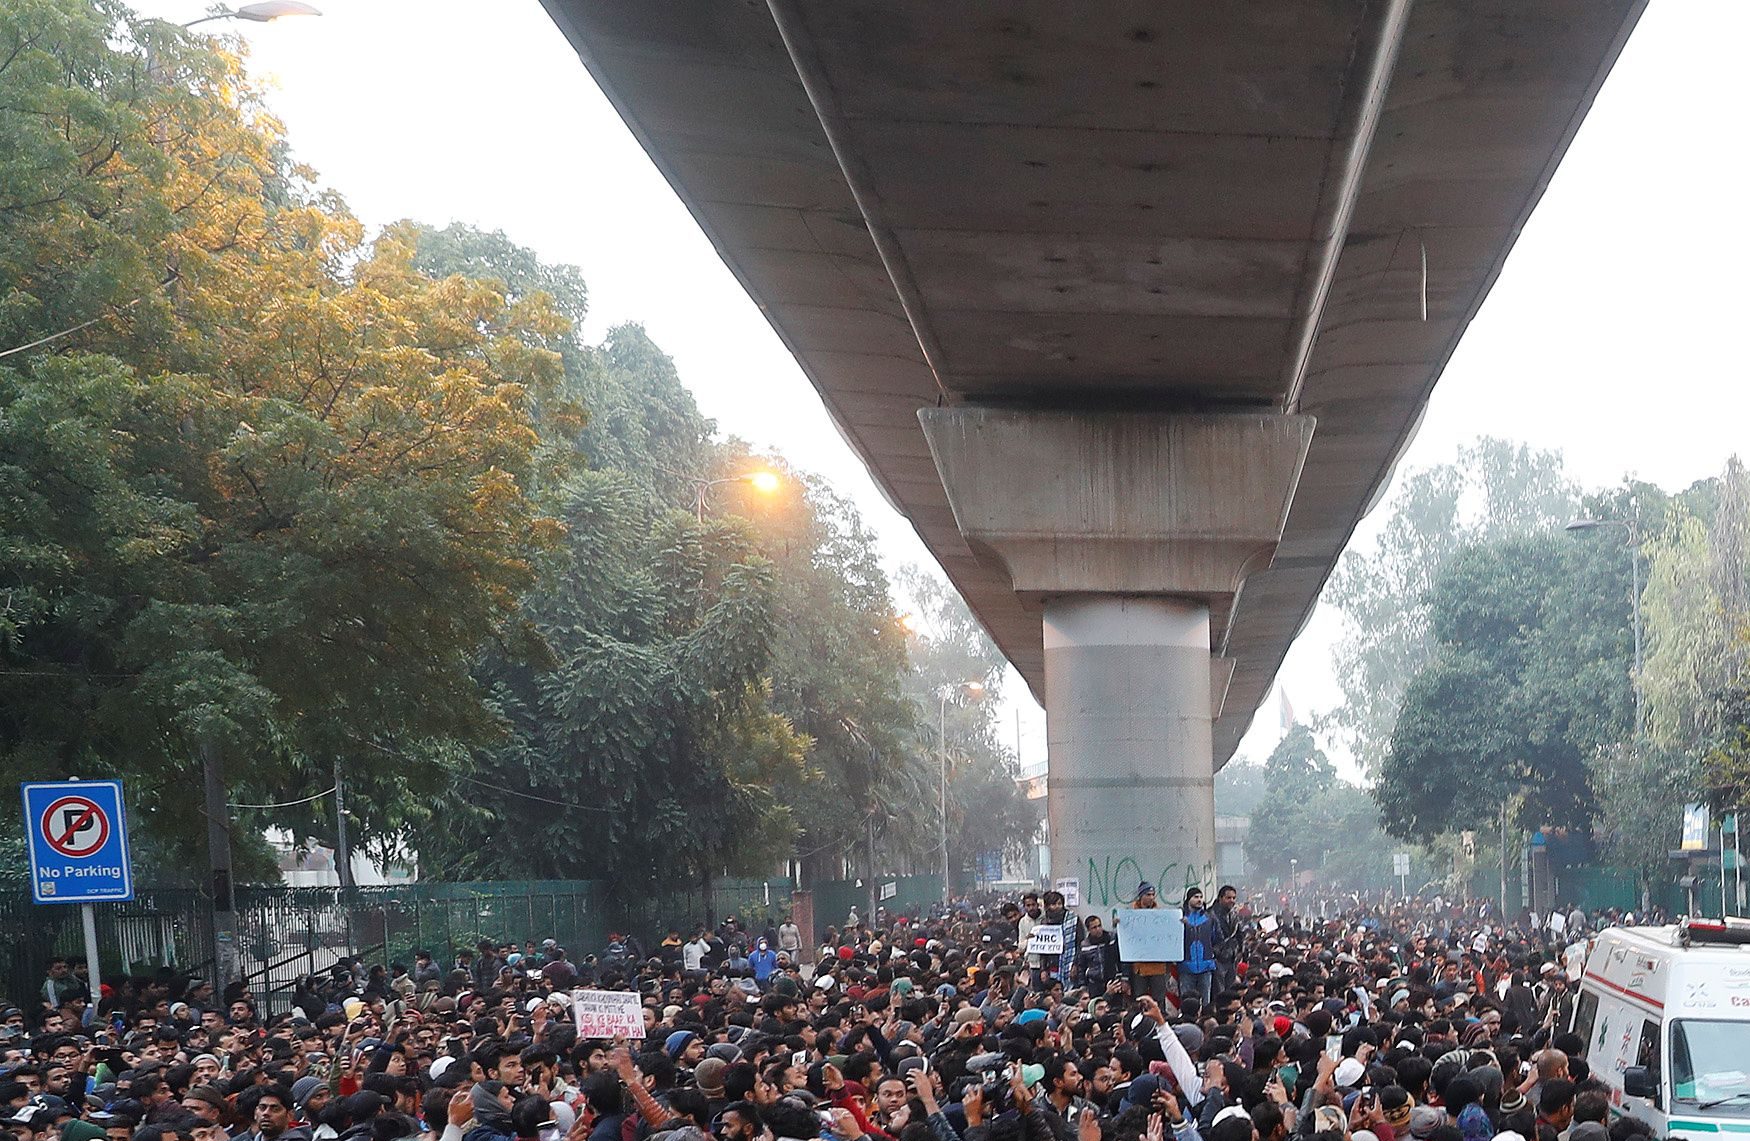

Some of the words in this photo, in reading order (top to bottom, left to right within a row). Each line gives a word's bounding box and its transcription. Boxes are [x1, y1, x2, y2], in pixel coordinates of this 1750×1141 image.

[40, 866, 60, 878] No
[64, 865, 121, 879] Parking
[1087, 856, 1143, 905] NO
[1036, 934, 1057, 943] NRC
